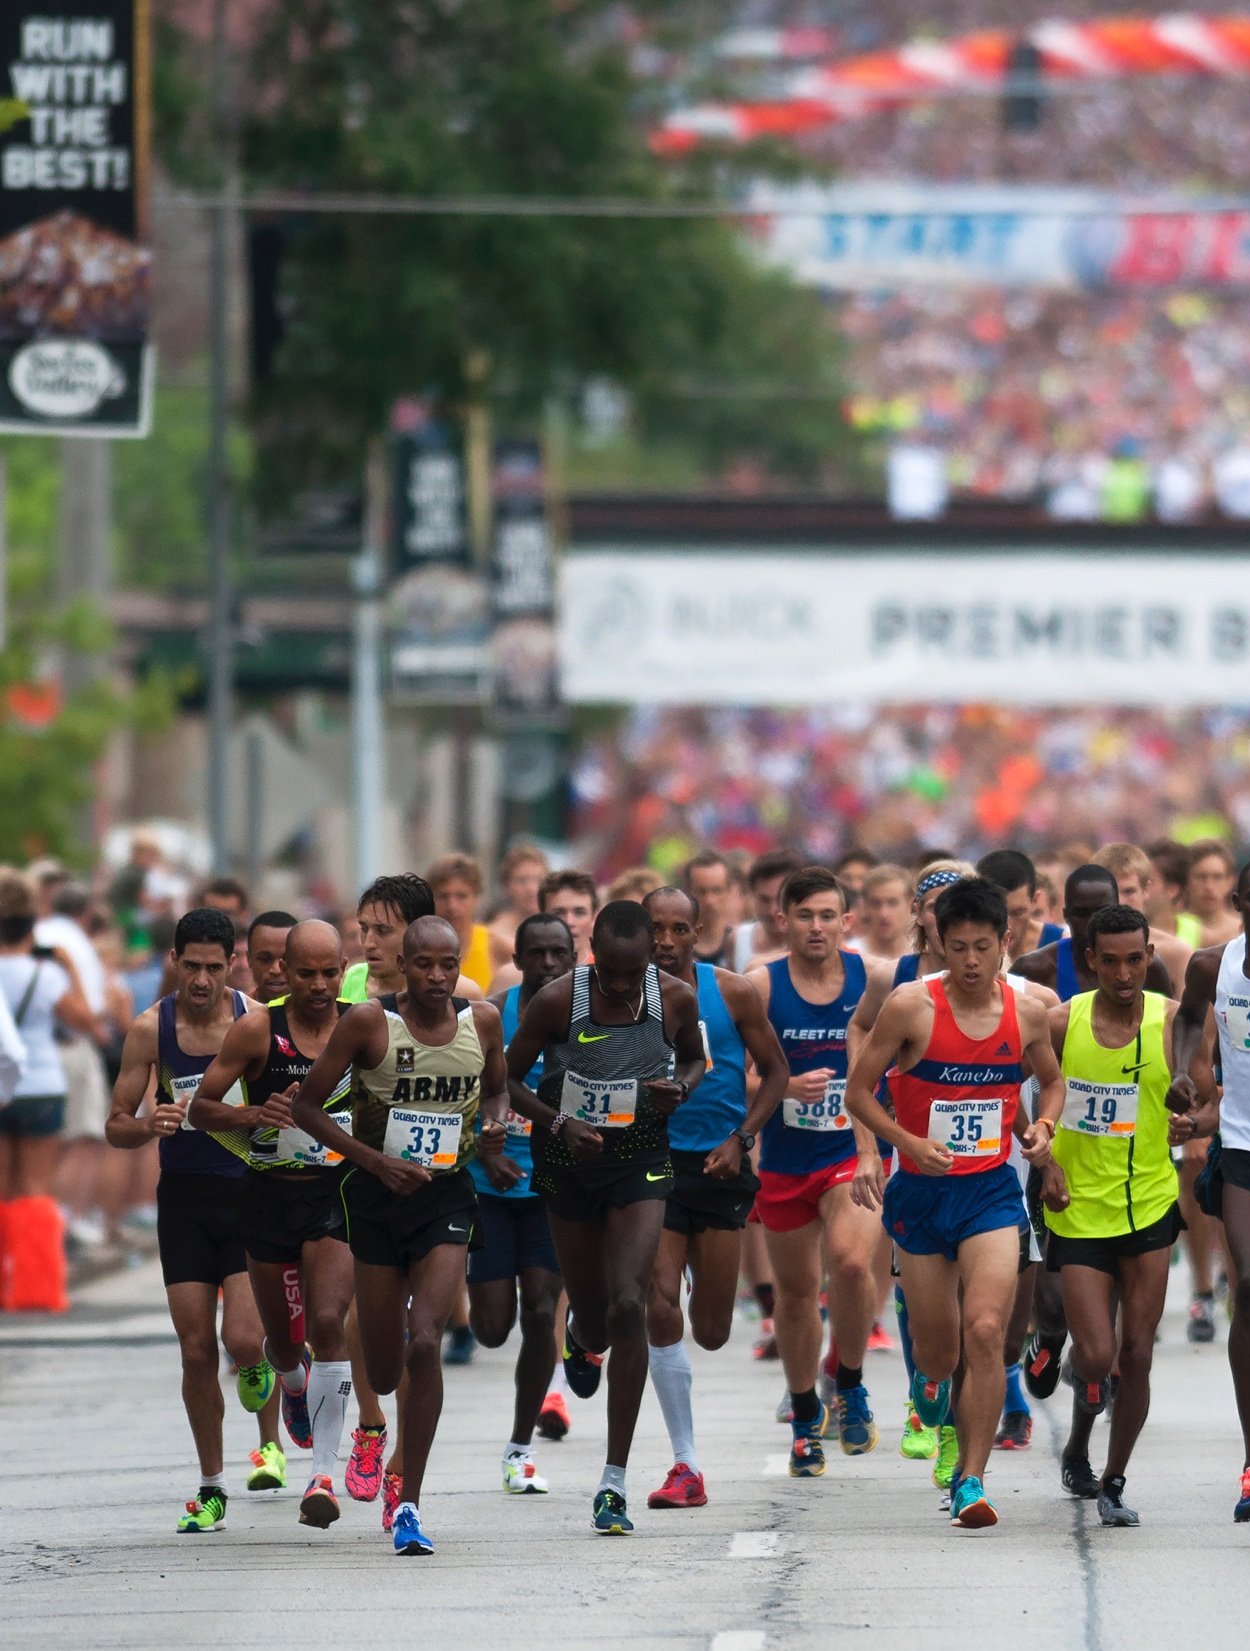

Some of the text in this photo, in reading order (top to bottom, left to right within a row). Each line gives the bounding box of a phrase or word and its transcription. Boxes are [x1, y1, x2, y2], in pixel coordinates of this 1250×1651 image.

[21, 19, 114, 60] RUN
[10, 63, 126, 104] WITH
[28, 107, 111, 145] THE
[2, 147, 130, 190] BEST!
[870, 600, 1182, 660] PREMIER
[1229, 998, 1249, 1008] QUAD
[783, 1029, 848, 1040] FLEET FE
[174, 1078, 198, 1089] QUAD
[568, 1074, 634, 1092] QUAD CITY TIMES
[939, 1066, 1003, 1082] Kanebo
[391, 1076, 478, 1103] ARMY
[1068, 1081, 1137, 1096] QUAD CITY TIMES
[581, 1091, 611, 1114] 31
[935, 1102, 1000, 1112] QUAD CITY TIMES
[1083, 1096, 1117, 1123] 19
[393, 1111, 461, 1126] QUAD CITY TIMES
[950, 1115, 984, 1142] 35
[406, 1126, 441, 1154] 33
[283, 1269, 305, 1320] USA
